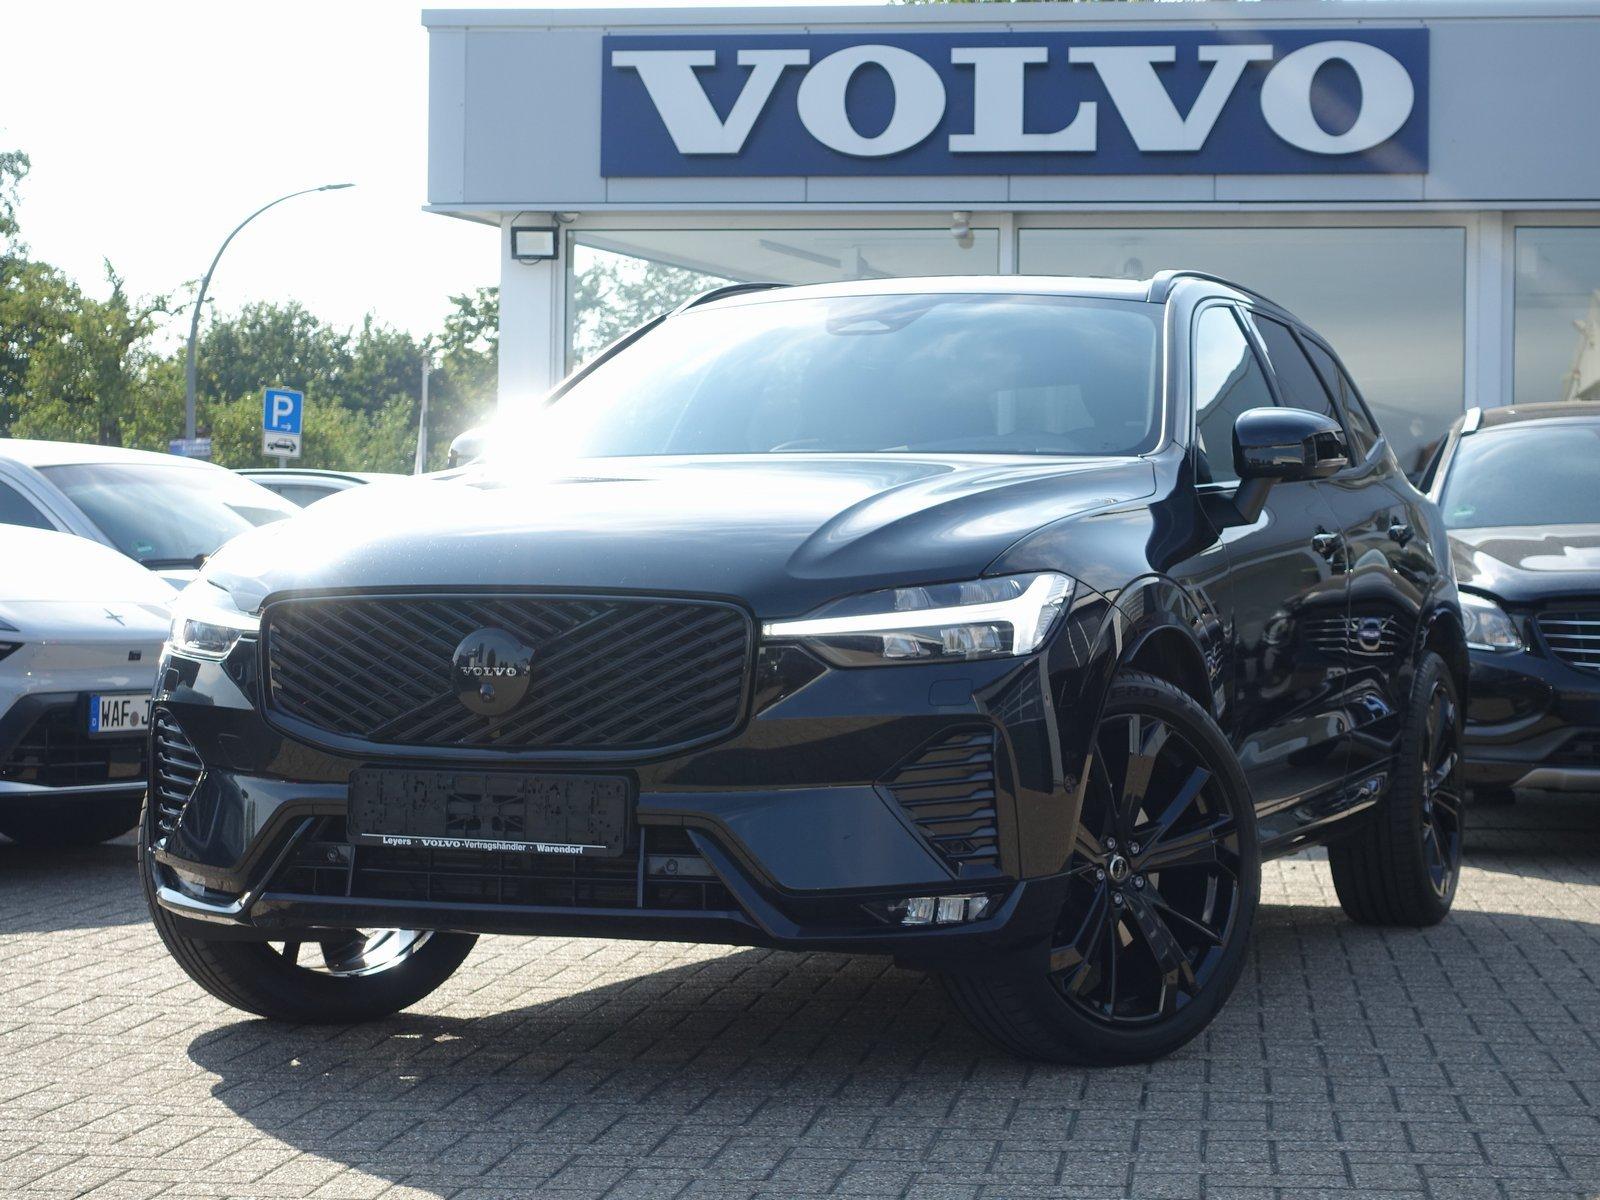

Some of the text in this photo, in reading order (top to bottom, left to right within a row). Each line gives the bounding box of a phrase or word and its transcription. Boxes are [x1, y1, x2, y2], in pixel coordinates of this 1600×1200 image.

[611, 40, 1415, 156] VOLVO
[272, 394, 294, 428] P
[461, 666, 517, 677] VOLVO
[101, 700, 131, 728] WAF
[382, 836, 412, 847] Leyers
[537, 843, 584, 854] Warendorf
